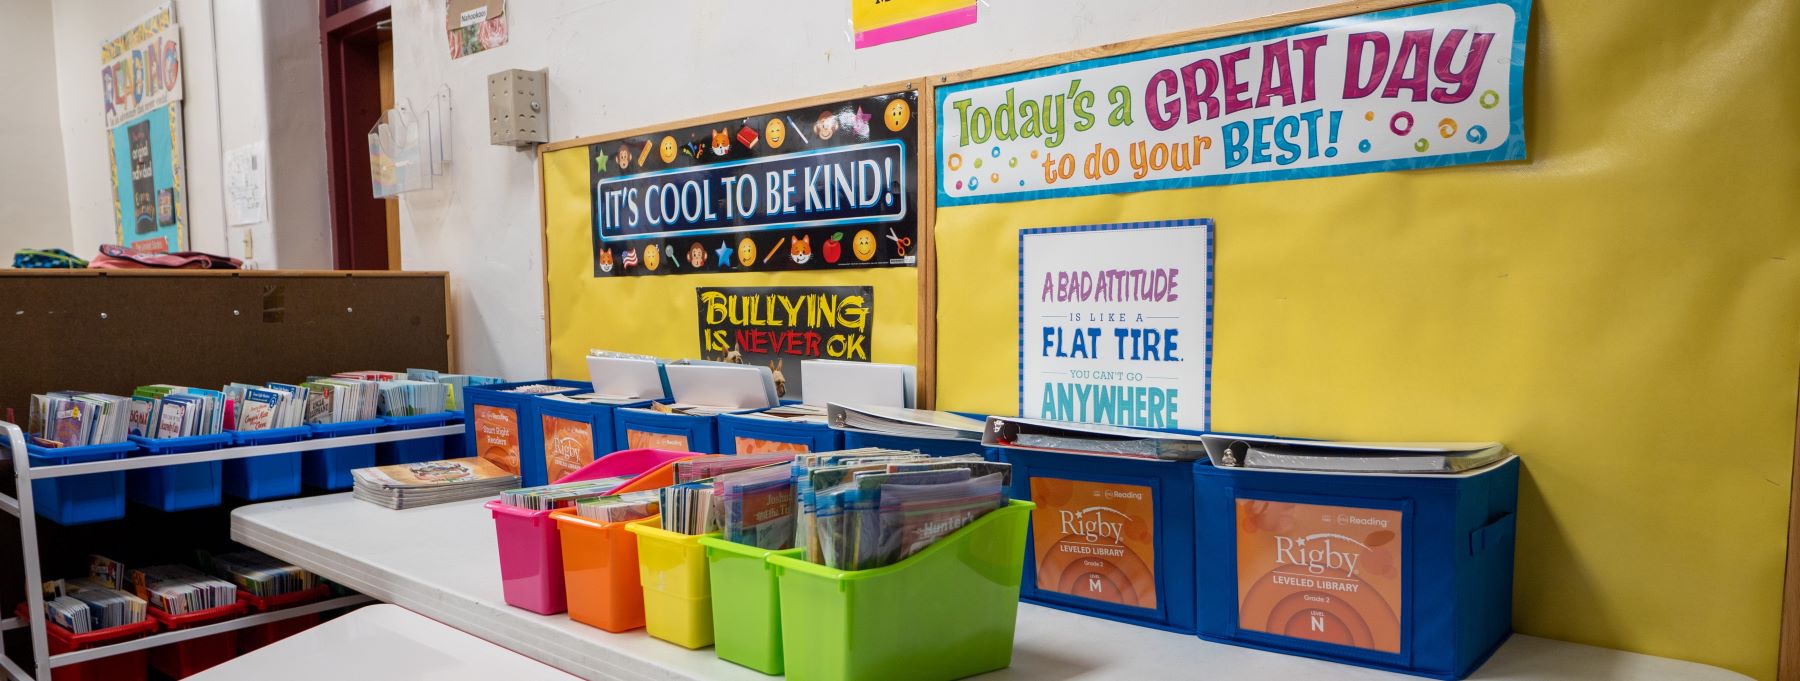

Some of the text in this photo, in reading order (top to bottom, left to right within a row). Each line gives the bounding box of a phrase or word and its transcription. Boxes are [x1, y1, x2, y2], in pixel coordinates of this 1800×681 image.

[102, 36, 179, 117] READING
[953, 28, 1496, 149] Today's a GREAT DAY
[1041, 108, 1344, 185] to do your BEST!
[604, 156, 894, 229] IT'S COOL TO BE KIND!
[1041, 268, 1179, 303] A BAD ATTITUDE
[701, 290, 870, 333] BULLYING
[1069, 313, 1144, 322] IS LIKE A
[703, 328, 867, 362] IS NEVER OK
[1042, 326, 1184, 362] FLAT TIRE.
[1070, 369, 1143, 382] YOU CAN'T GO
[1041, 382, 1178, 429] ANYWHERE
[554, 437, 581, 463] Rigby
[1113, 490, 1142, 500] Reading
[1059, 509, 1123, 544] Rigby
[1349, 515, 1388, 528] Reading
[1060, 544, 1124, 557] LEVELED LIBRARY
[1273, 535, 1360, 578] Rigby
[1088, 578, 1102, 593] M
[1272, 575, 1359, 593] LEVELED LIBRARY
[1303, 594, 1330, 604] Grade 2
[1311, 616, 1324, 632] N
